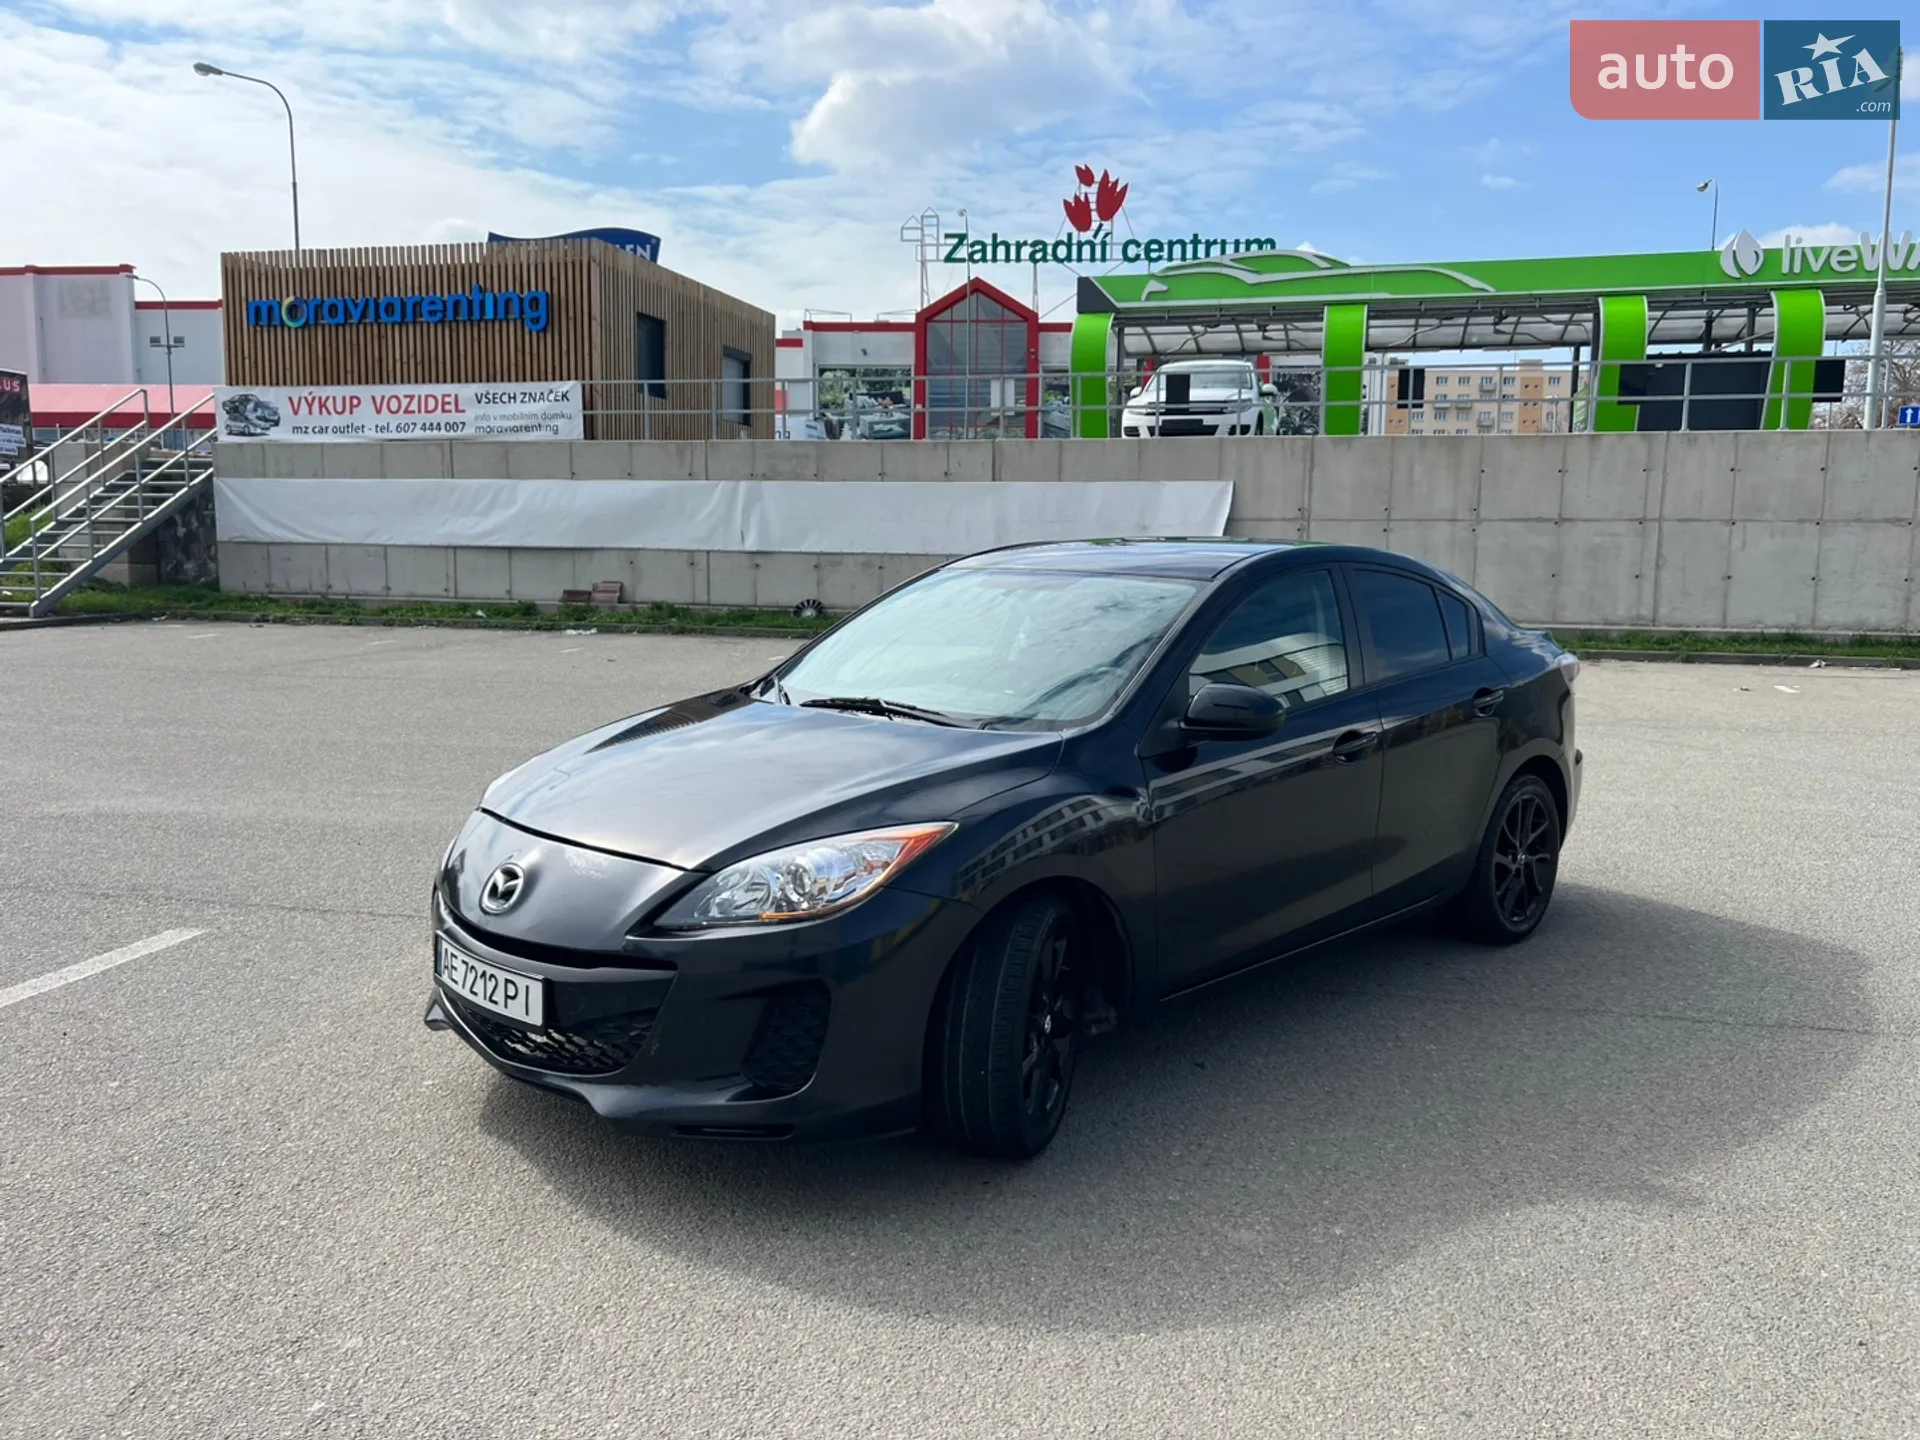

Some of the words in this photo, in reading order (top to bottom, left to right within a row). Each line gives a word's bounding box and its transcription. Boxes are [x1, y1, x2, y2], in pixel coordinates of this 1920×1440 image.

[943, 223, 1111, 264] Zahradní
[247, 284, 550, 333] moraviarenting
[288, 391, 362, 416] VÝKUP
[371, 394, 466, 415] VOZIDEL
[474, 389, 517, 405] VŠECH
[520, 388, 570, 404] ZNAČEK
[541, 410, 572, 420] domku
[292, 424, 309, 435] mz
[312, 424, 328, 435] car
[332, 422, 366, 435] outlet
[375, 422, 393, 434] tel.
[395, 422, 417, 434] 607
[420, 422, 442, 433] 444
[445, 421, 466, 433] 007
